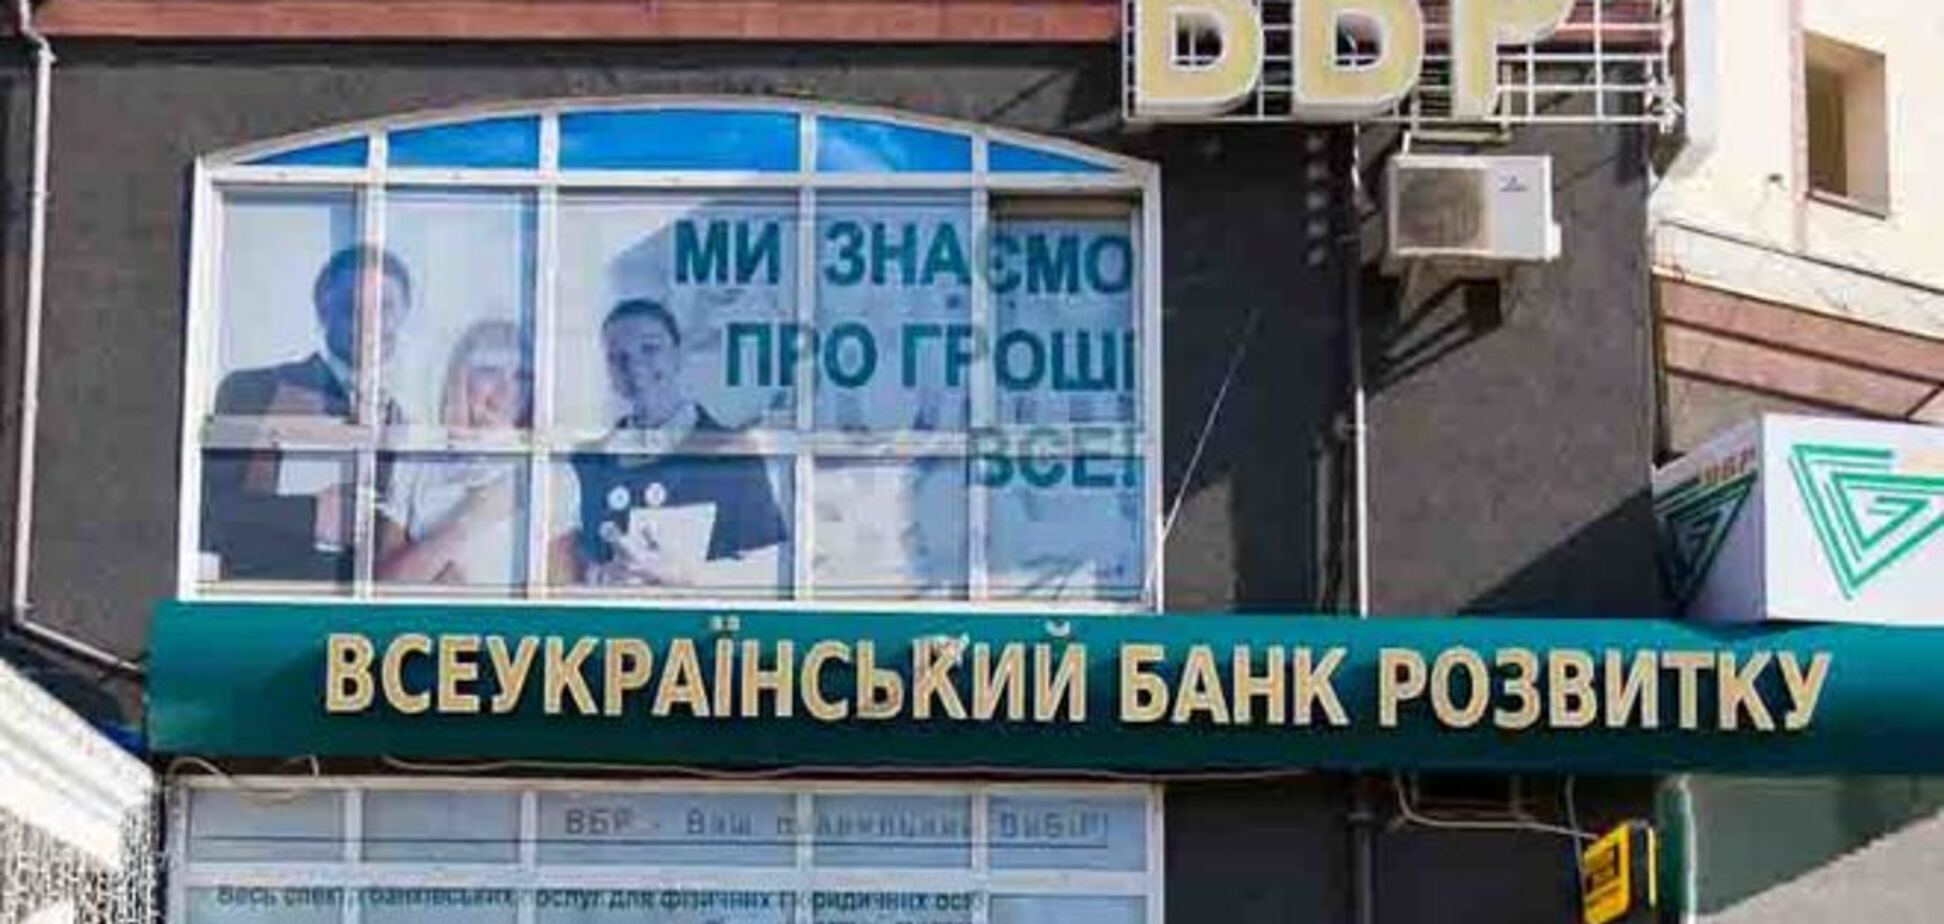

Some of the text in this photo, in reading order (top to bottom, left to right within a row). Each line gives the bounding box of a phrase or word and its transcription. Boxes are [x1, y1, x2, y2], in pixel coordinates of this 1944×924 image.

[674, 219, 1134, 295] МИ ЗНАЄМО
[725, 321, 1135, 392] ПРО ГРОШІ
[324, 614, 1832, 732] ВСЕУКРАЇНСЬКИЙ БАНК РОЗВИТКУ
